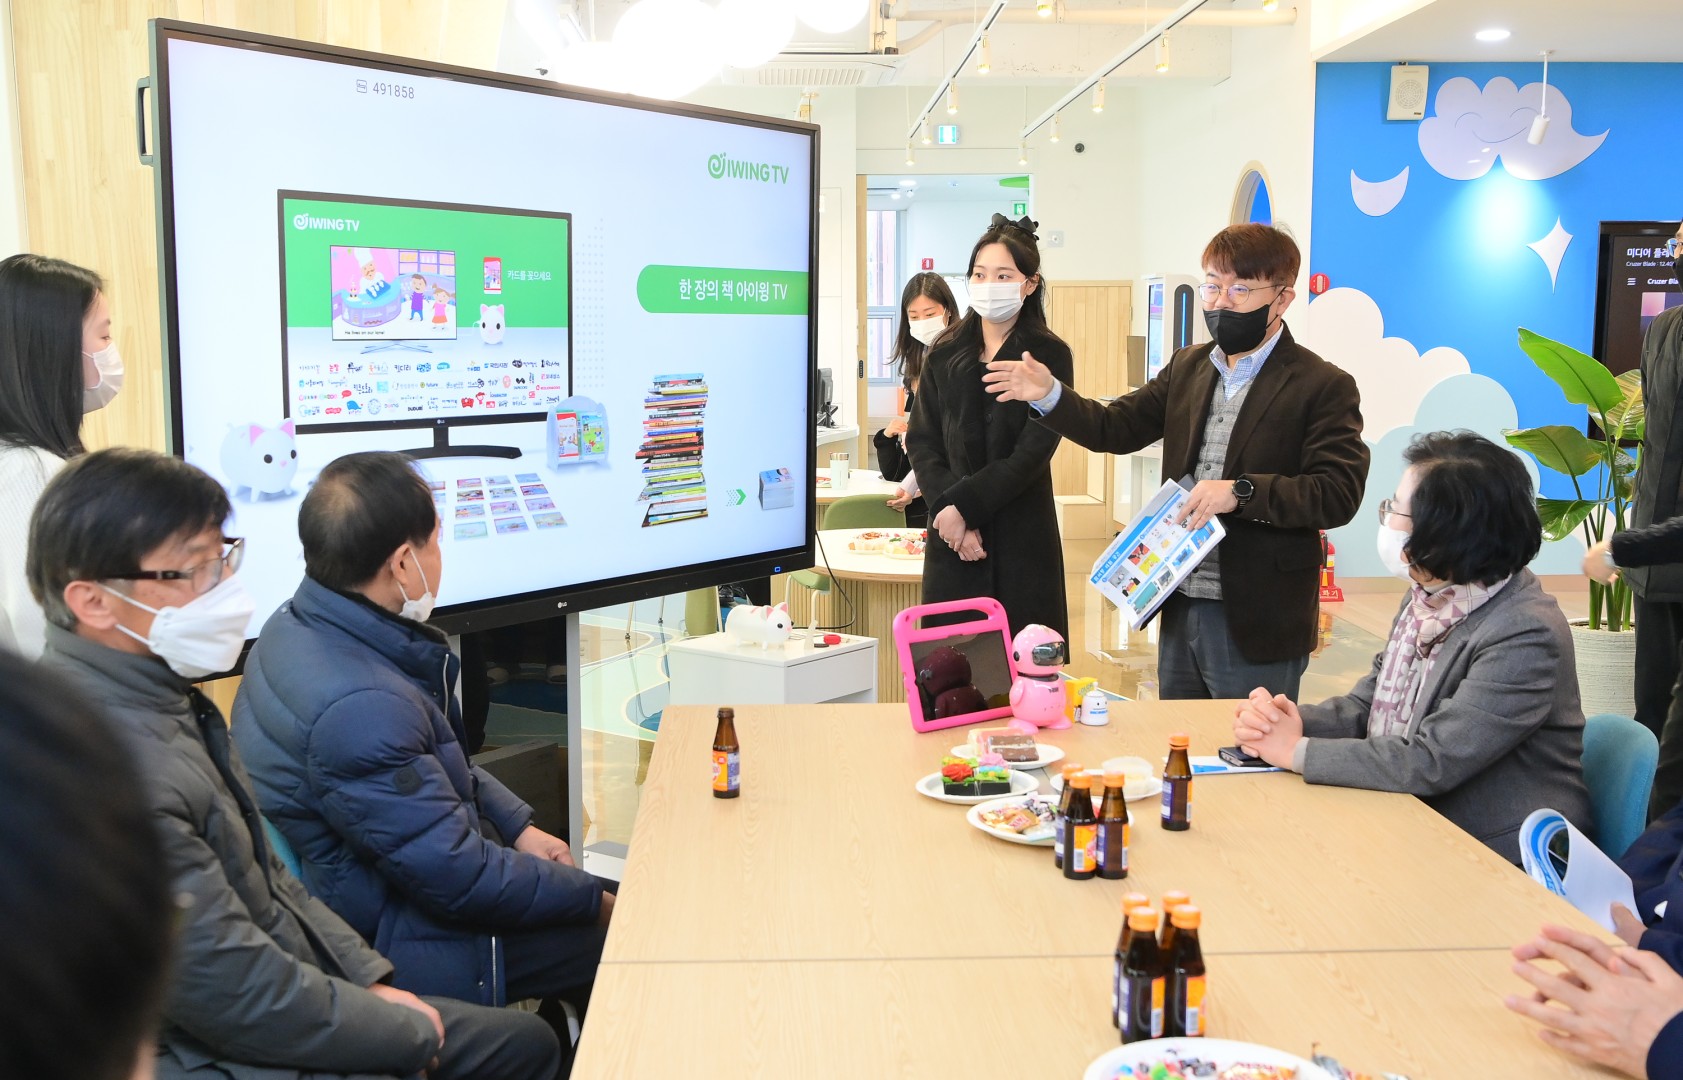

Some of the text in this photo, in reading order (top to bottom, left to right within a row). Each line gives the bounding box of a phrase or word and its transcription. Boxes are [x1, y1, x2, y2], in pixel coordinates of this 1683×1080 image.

[372, 82, 415, 99] 491858
[771, 165, 790, 185] TV
[345, 219, 360, 232] TV
[1626, 247, 1670, 258] 미디어 플레
[507, 270, 526, 281] 카드를
[678, 278, 788, 302] 한 장의 책 아이윙 TV
